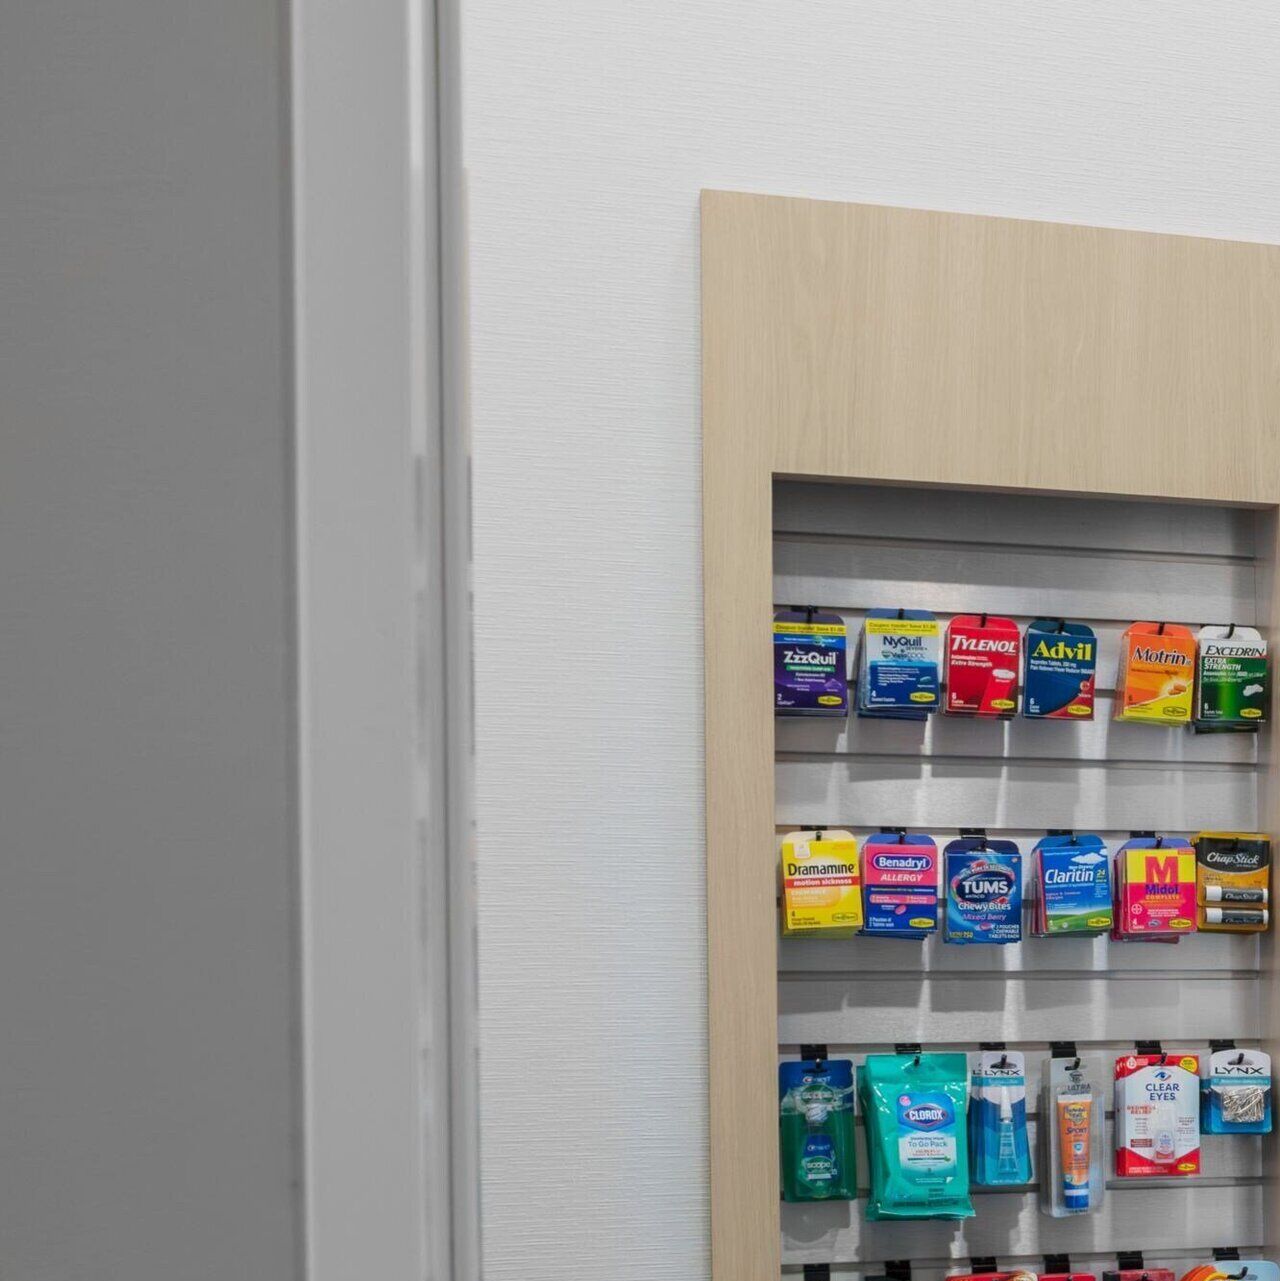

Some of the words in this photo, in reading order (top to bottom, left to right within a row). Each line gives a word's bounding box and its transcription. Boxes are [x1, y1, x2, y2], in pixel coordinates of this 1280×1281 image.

[883, 635, 922, 649] NyQuil
[951, 634, 1017, 653] TYLENOL
[1032, 639, 1093, 661] Advil
[1132, 646, 1187, 666] Motrin
[1204, 644, 1266, 657] EXCEDRIN
[783, 649, 838, 666] ZzzQuil
[1204, 657, 1227, 665] EXTRA
[1204, 662, 1242, 671] STRENGTH
[878, 856, 927, 870] Benadryl
[1206, 851, 1260, 866] ChapStick
[788, 862, 855, 877] Dramamine
[1145, 856, 1179, 883] M
[793, 878, 817, 887] motion
[817, 877, 852, 886] sickness
[880, 873, 924, 883] ALLERGY
[1045, 868, 1094, 884] Claritin
[962, 880, 1009, 895] TUMS
[1145, 883, 1180, 895] Midol
[958, 902, 986, 912] Chewy
[986, 901, 1012, 911] Bites
[962, 912, 988, 921] Mixed
[988, 913, 1007, 922] Berry
[1214, 1066, 1264, 1075] LYNX
[1145, 1083, 1180, 1092] CLEAR
[1149, 1092, 1176, 1101] EYES
[909, 1109, 944, 1121] CLOROX
[918, 1140, 929, 1148] Go
